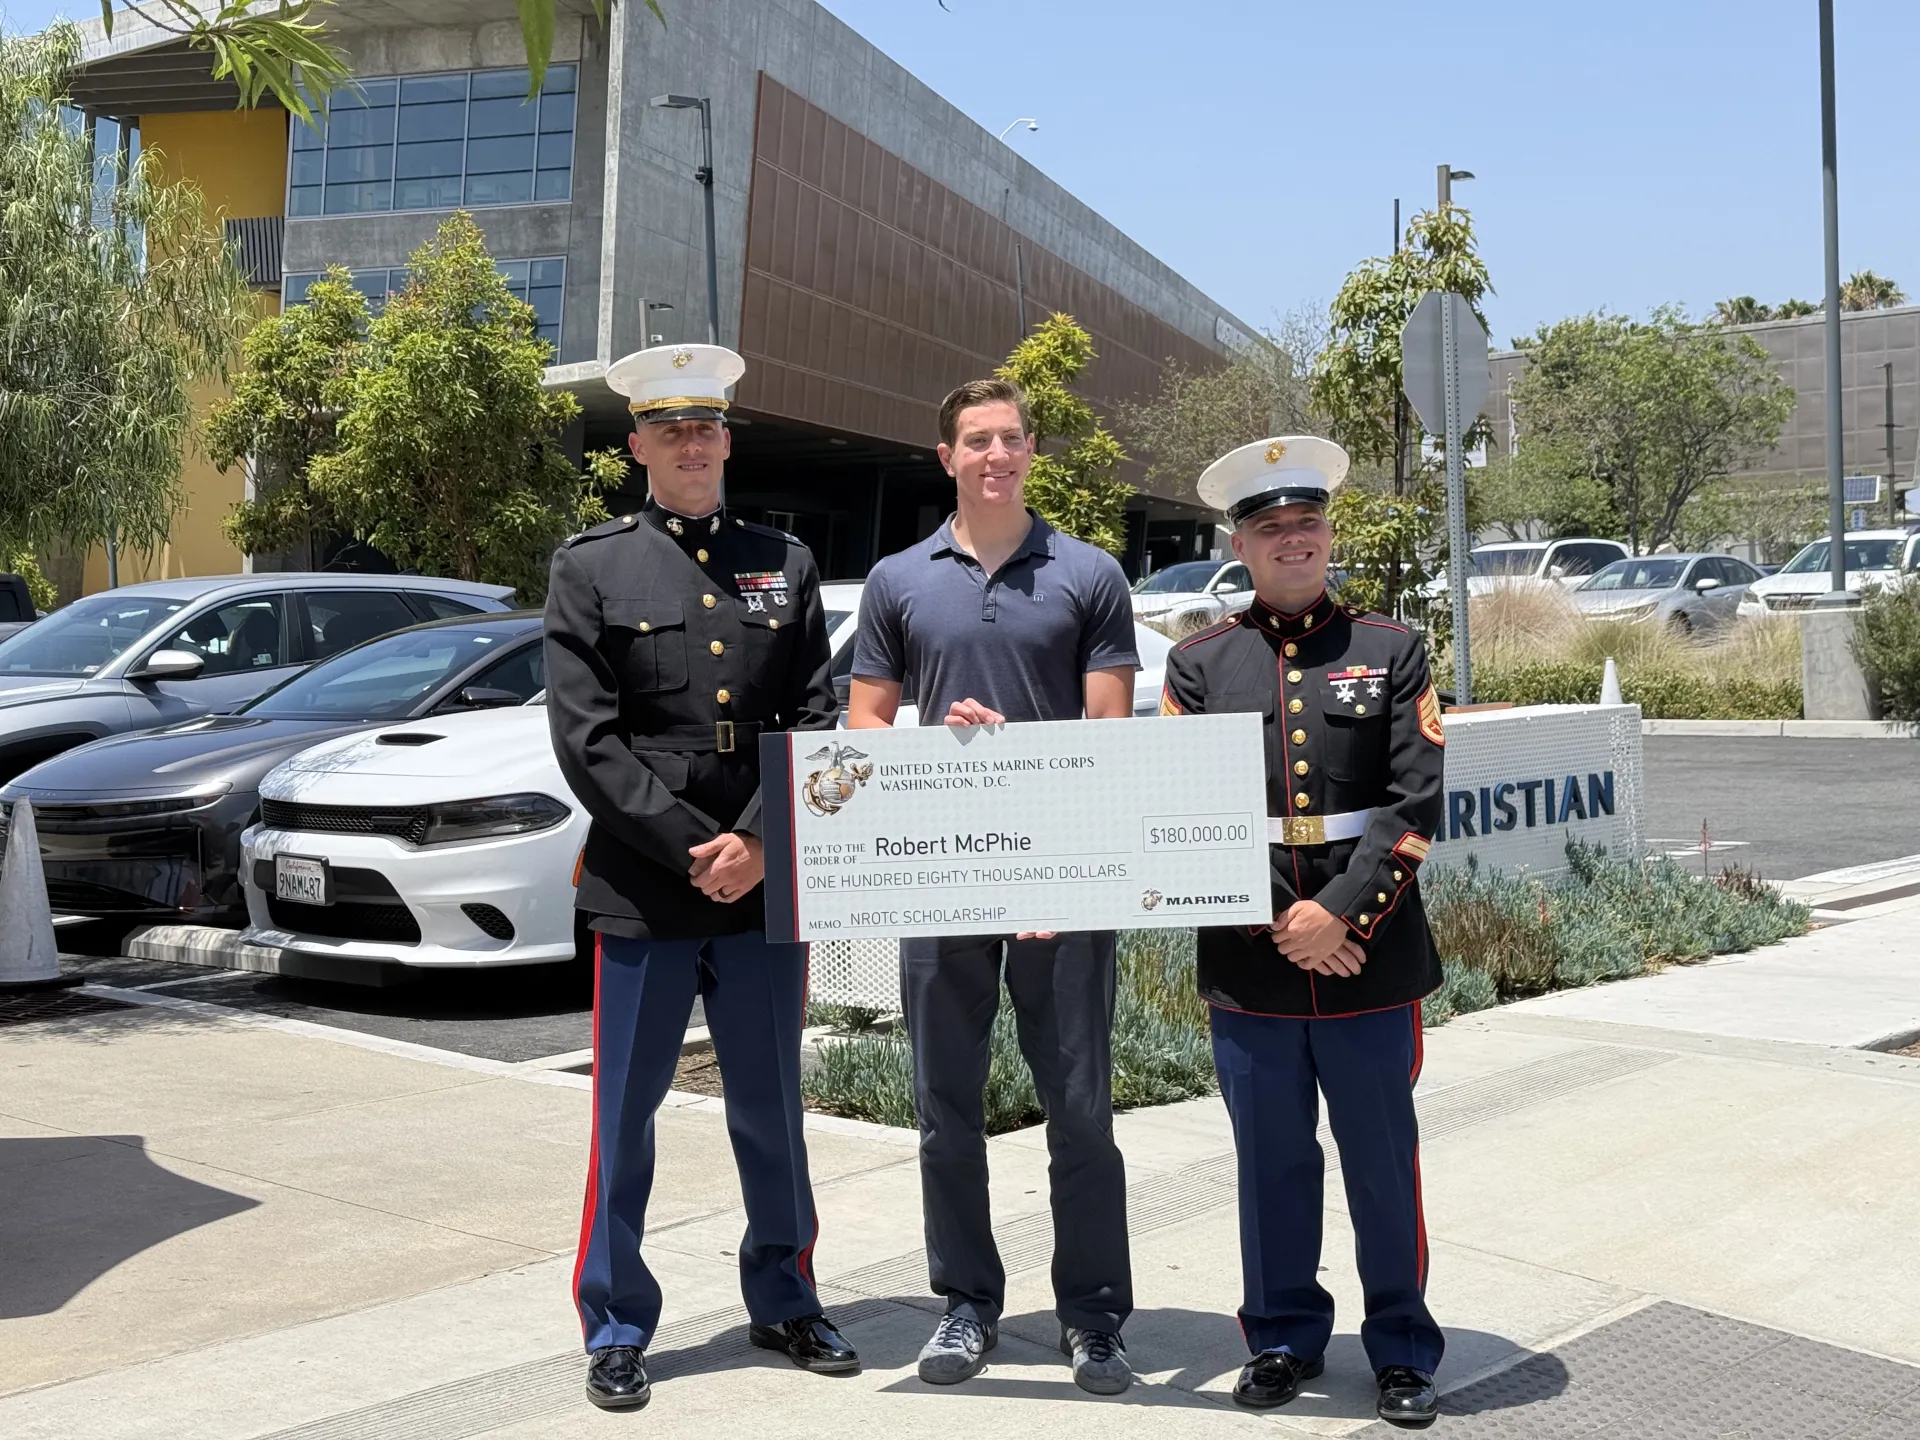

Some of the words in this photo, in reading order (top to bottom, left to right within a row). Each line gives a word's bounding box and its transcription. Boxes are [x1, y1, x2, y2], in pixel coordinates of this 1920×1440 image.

[880, 763, 932, 776] UNITED
[937, 760, 987, 774] STATES
[992, 758, 1044, 772] MARINE
[1049, 756, 1095, 769] CORPS
[983, 776, 1011, 788] D.C.
[1435, 771, 1614, 842] RISTIAN
[875, 836, 947, 857] Robert
[955, 832, 1031, 853] McPhie
[1150, 825, 1247, 845] $180,000.00
[804, 845, 823, 855] PAY
[826, 844, 842, 853] TO
[845, 843, 866, 853] THE
[804, 856, 840, 866] ORDER
[843, 855, 858, 864] OF
[279, 872, 321, 900] 9NAM487
[806, 875, 836, 889] ONE
[841, 873, 912, 887] HUNDRED
[918, 870, 969, 885] EIGHTY
[972, 867, 1054, 883] THOUSAND
[1059, 864, 1127, 879] DOLLARS
[1166, 894, 1250, 906] MARINES
[808, 919, 842, 930] MEMO
[850, 911, 898, 925] NROTC
[903, 907, 1007, 923] SCHOLARSHIP
